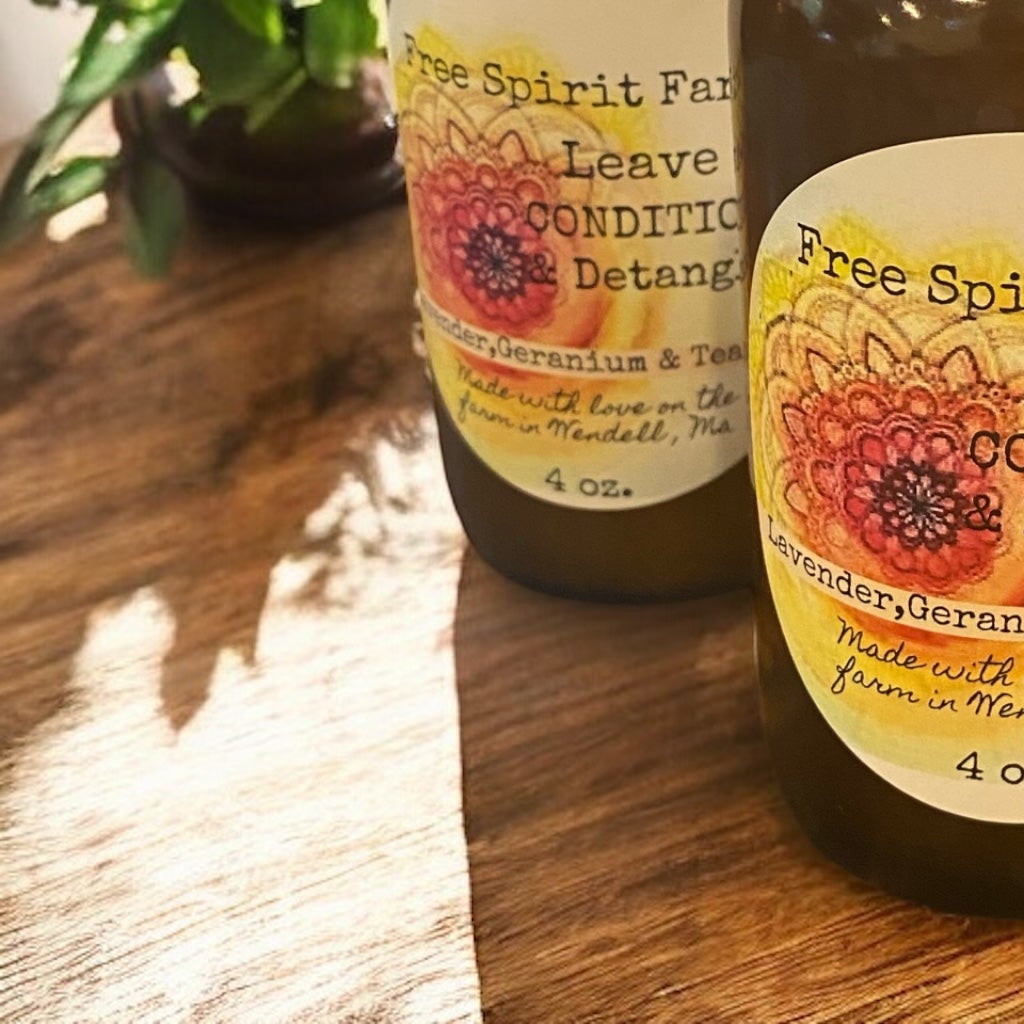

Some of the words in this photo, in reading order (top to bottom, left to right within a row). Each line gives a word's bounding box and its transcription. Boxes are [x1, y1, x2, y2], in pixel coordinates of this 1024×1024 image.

[404, 32, 469, 89] Free
[483, 62, 644, 109] Spirit
[659, 70, 733, 105] Far
[560, 140, 719, 179] Leave
[526, 197, 738, 239] CONDITIO
[573, 248, 741, 292] Detang
[797, 222, 908, 298] Free
[659, 349, 681, 370] &
[691, 343, 742, 367] Tea
[457, 389, 514, 424] farm
[519, 416, 541, 434] in
[547, 416, 679, 447] Wendell,
[688, 414, 732, 441] Ma
[519, 387, 580, 415] with
[590, 394, 651, 416] love
[657, 398, 687, 416] on
[696, 382, 740, 411] the
[545, 467, 566, 492] 4
[579, 477, 634, 498] oz.
[965, 495, 1001, 532] &
[835, 614, 927, 671] Made
[932, 656, 1017, 688] with
[830, 657, 919, 695] farm
[927, 690, 959, 713] in
[955, 750, 985, 782] 4
